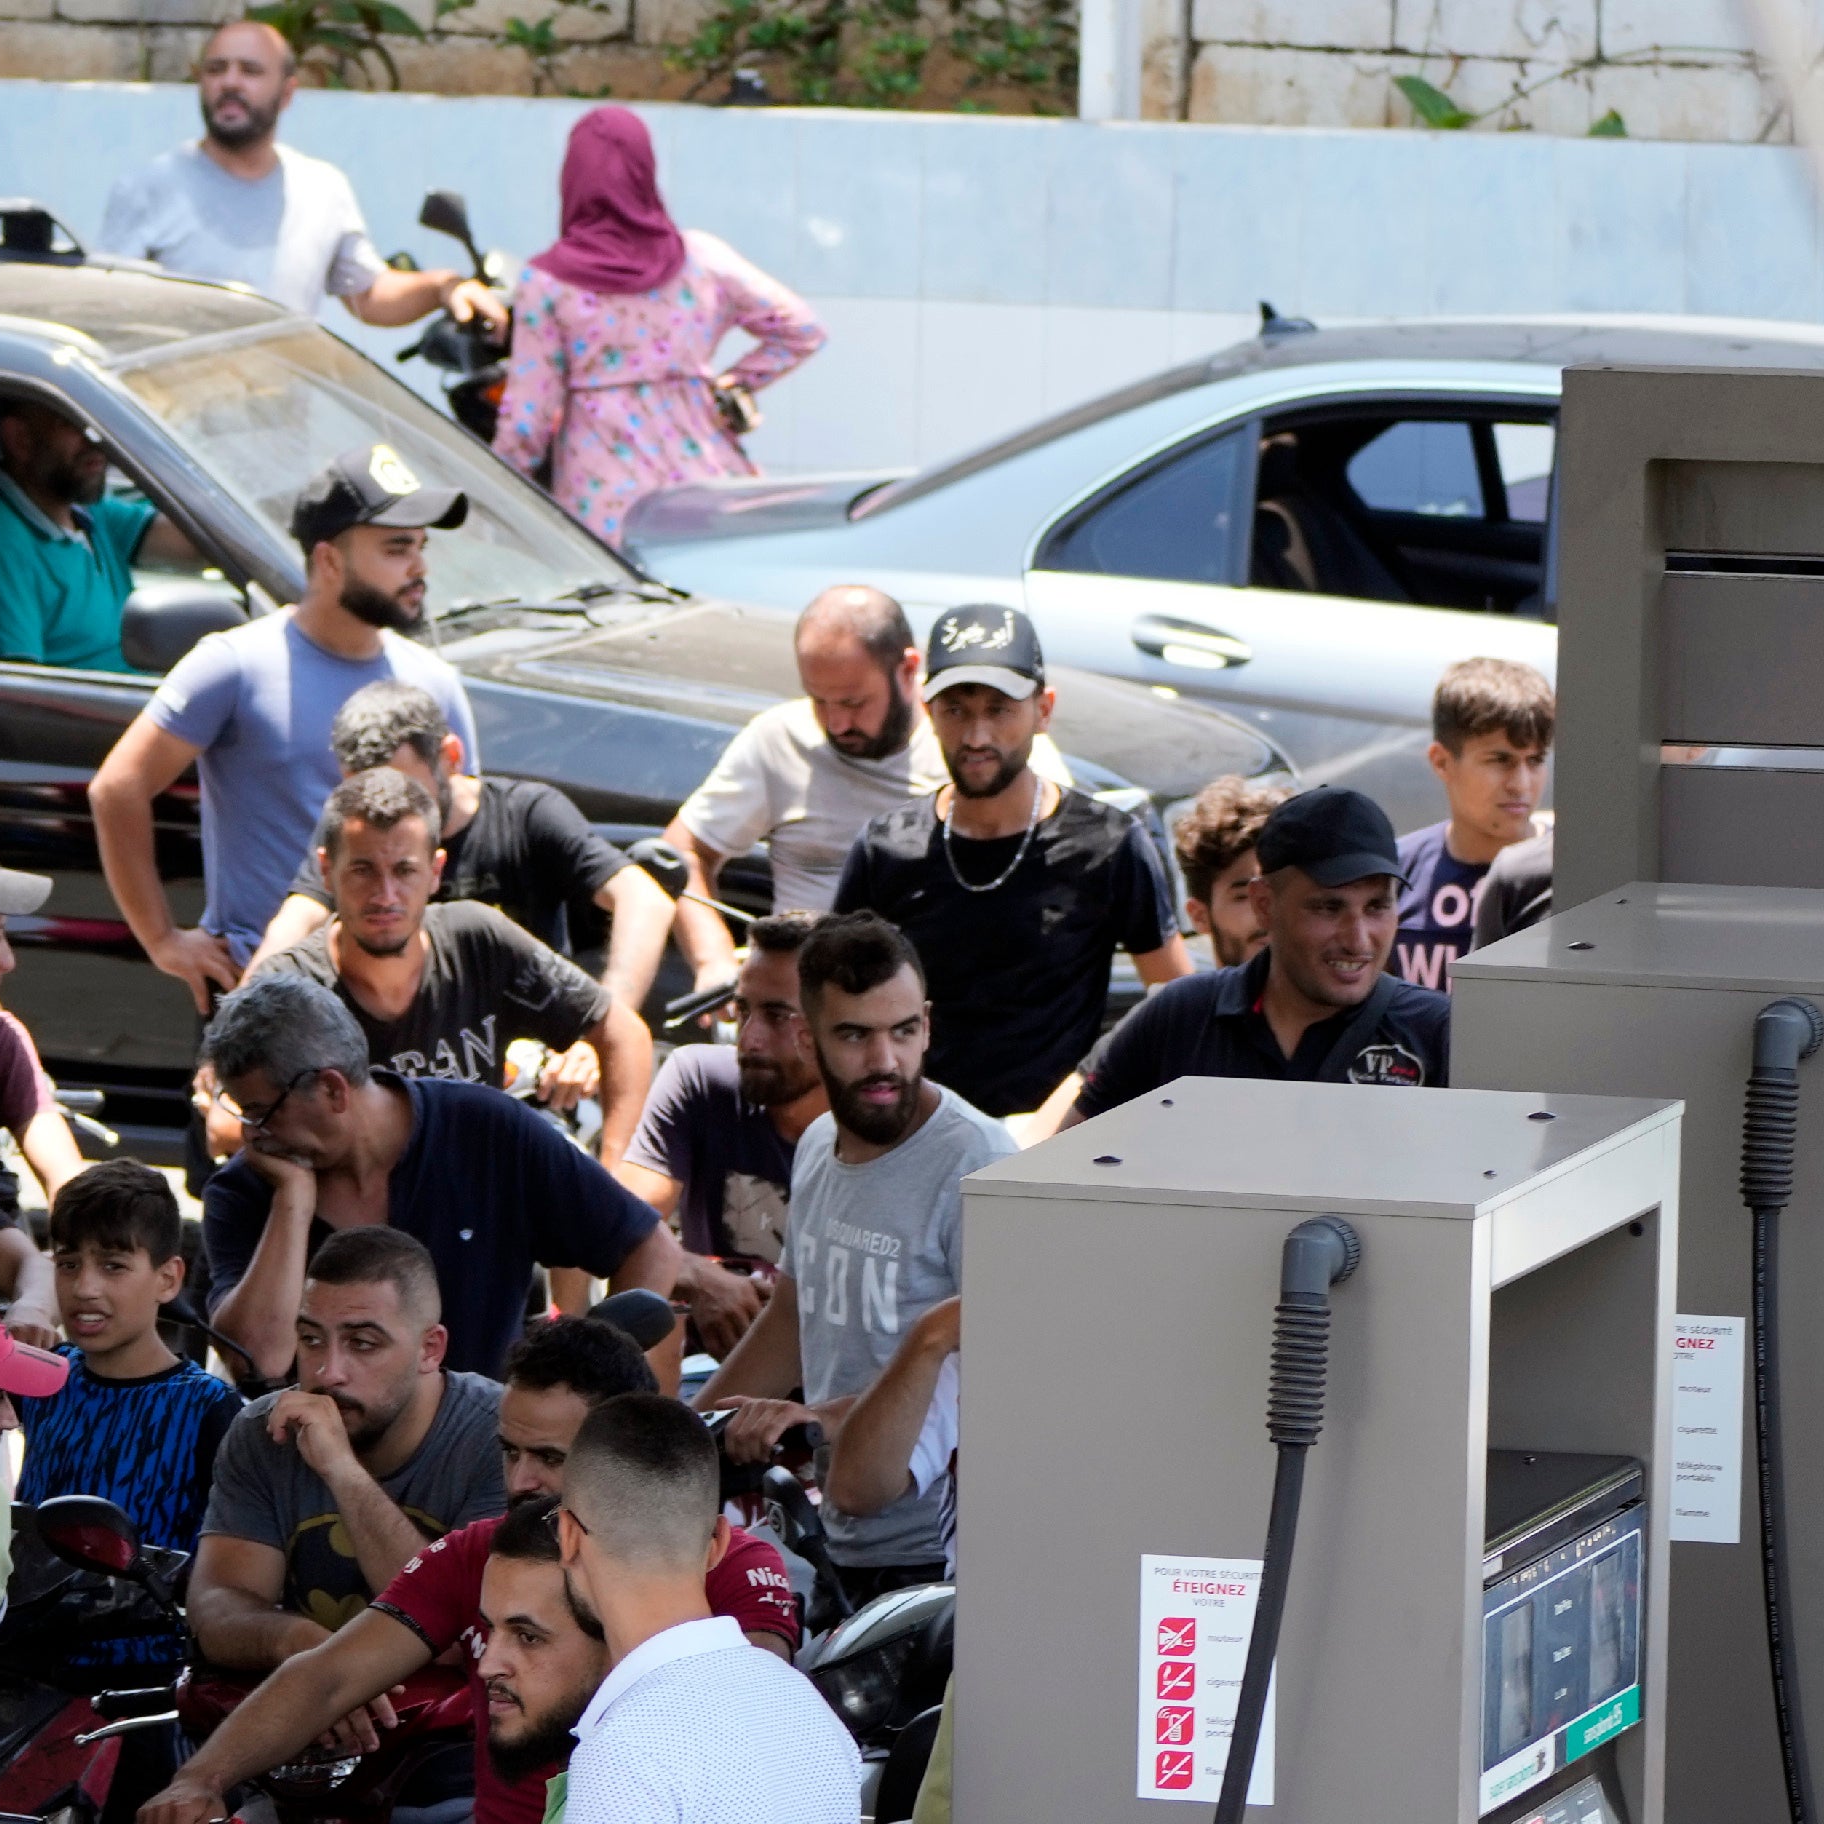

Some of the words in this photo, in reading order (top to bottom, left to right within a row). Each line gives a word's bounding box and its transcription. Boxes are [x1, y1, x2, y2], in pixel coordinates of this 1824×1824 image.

[1675, 1337, 1715, 1350] GNEZ
[1154, 1567, 1182, 1577] POUR
[1184, 1568, 1217, 1579] VOTRE
[1218, 1567, 1262, 1581] SÉCURIT
[1172, 1579, 1247, 1597] ÉTEIGNEZ
[1192, 1598, 1226, 1608] VOTRE
